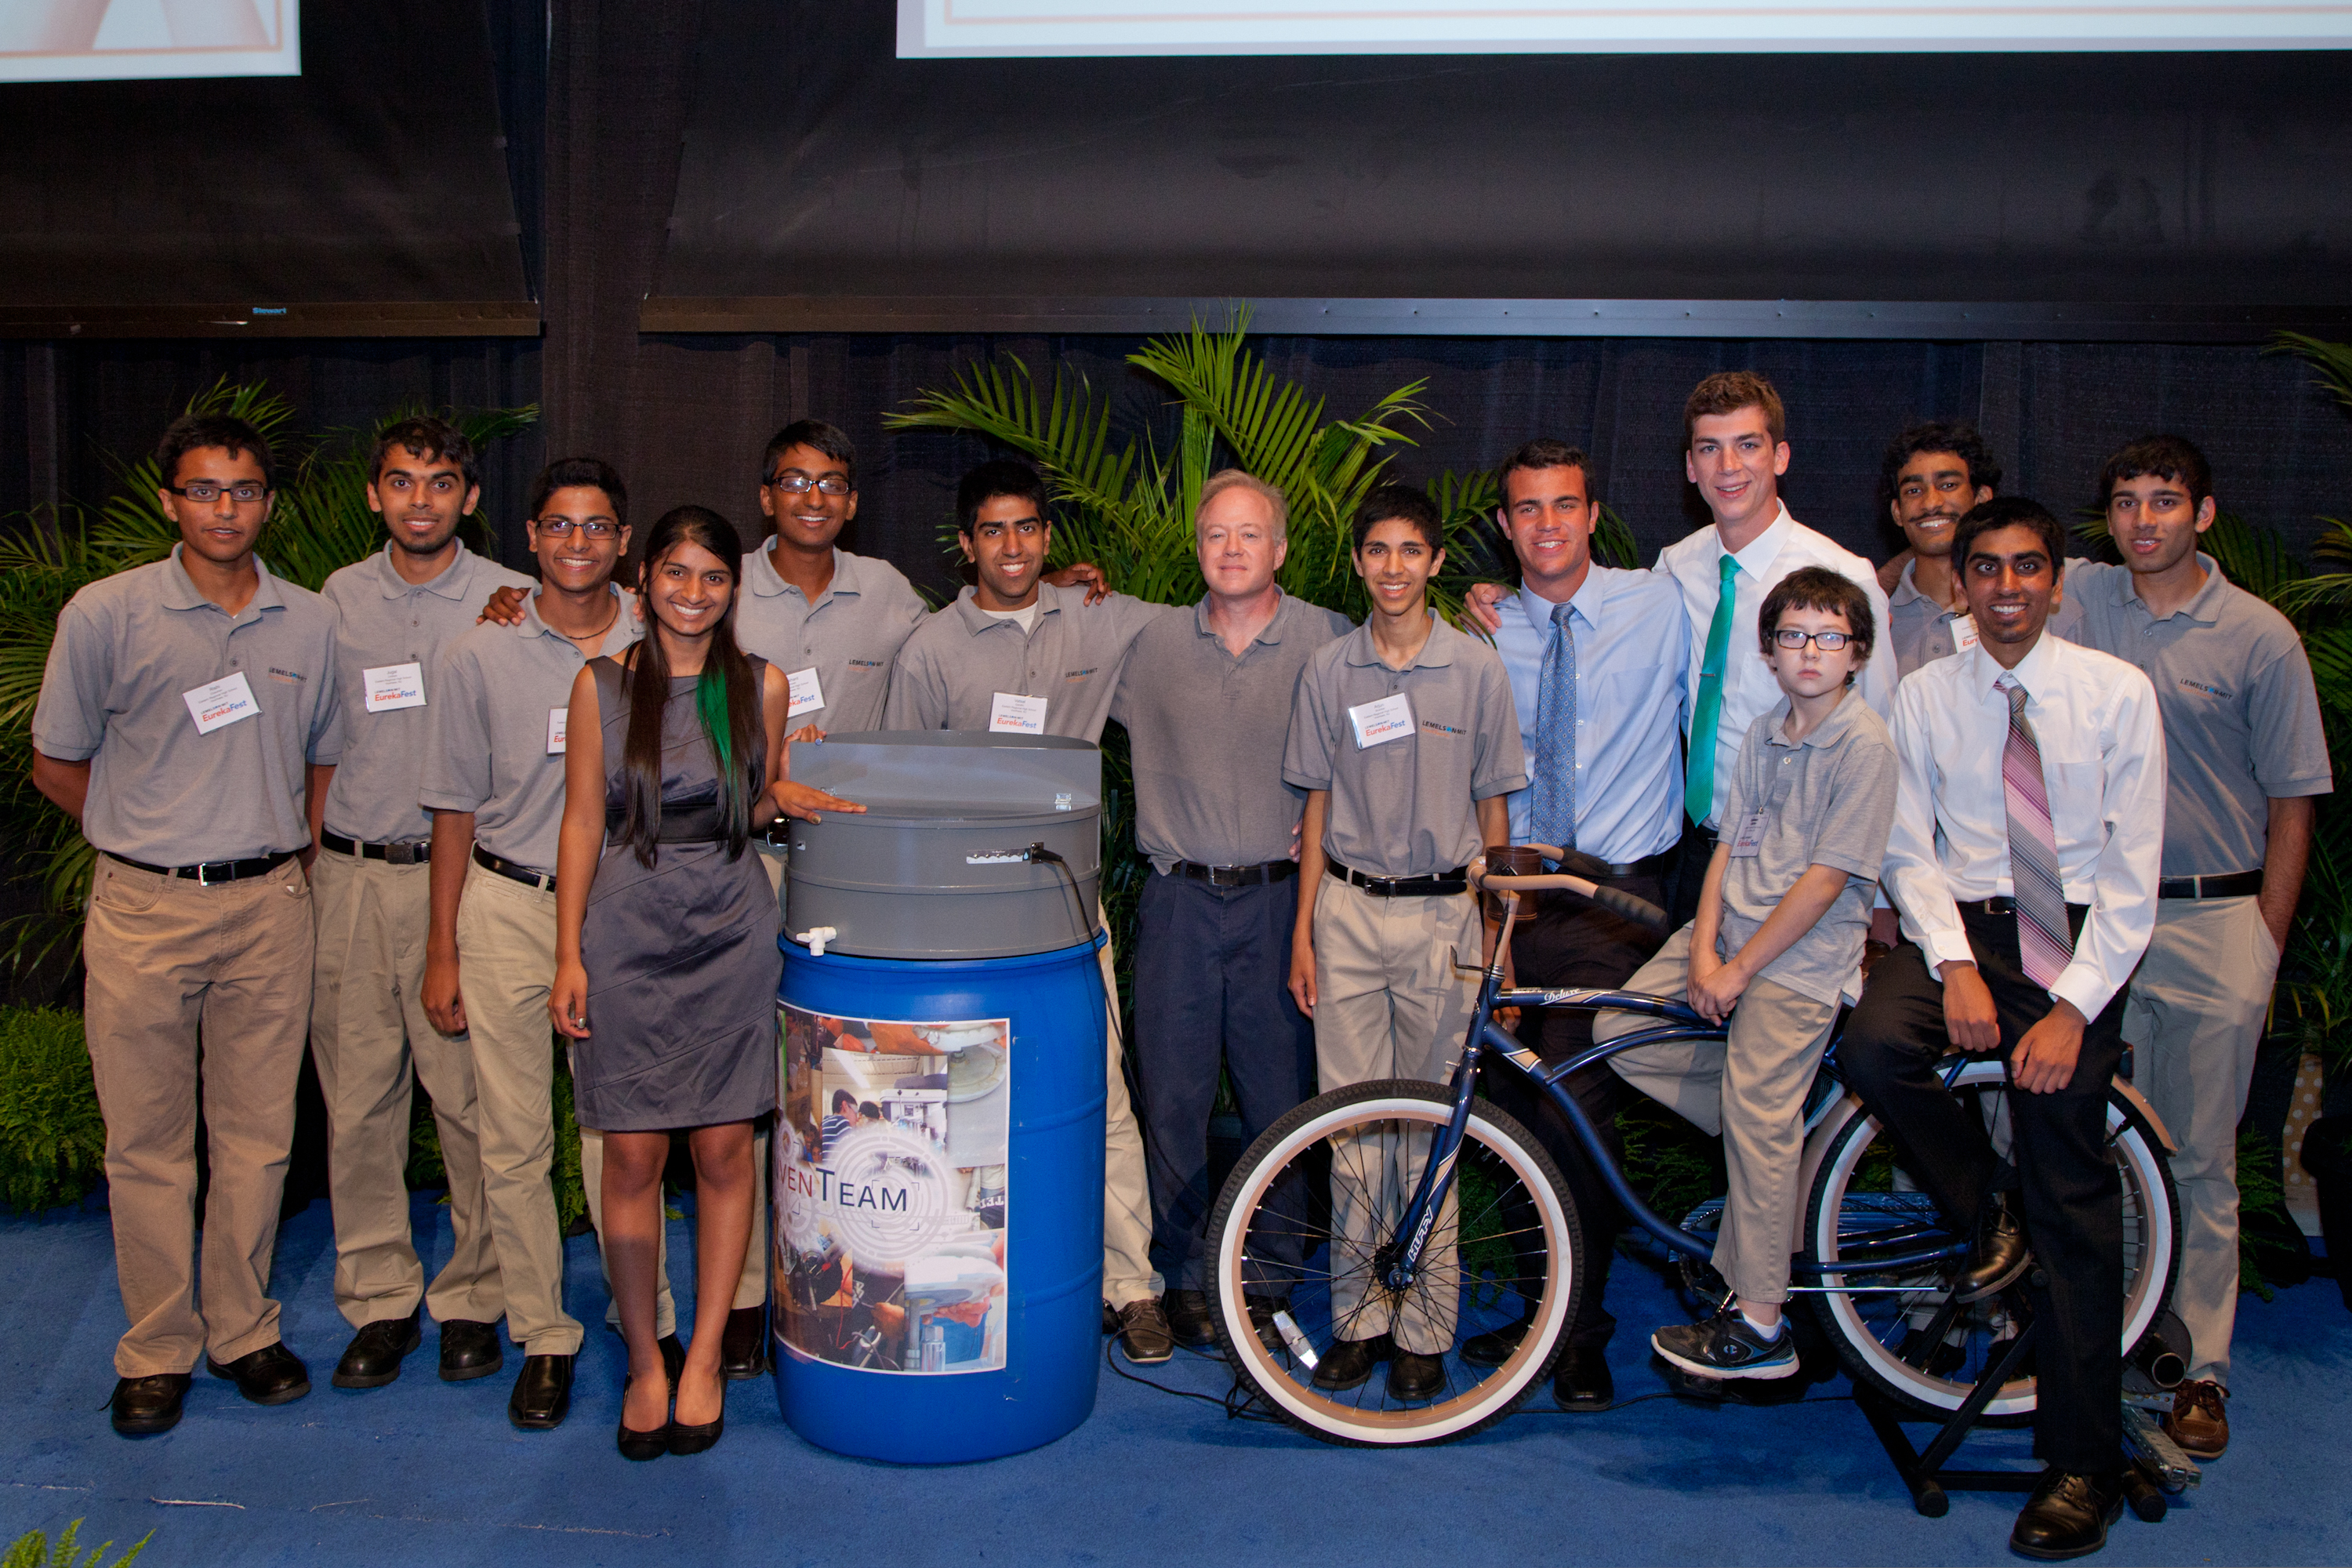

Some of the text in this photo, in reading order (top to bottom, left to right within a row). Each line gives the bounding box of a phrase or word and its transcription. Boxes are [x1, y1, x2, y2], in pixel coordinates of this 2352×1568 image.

[375, 690, 417, 702] EurekaFest
[201, 700, 248, 723] EurekaFest
[996, 717, 1037, 729] EurekaFest
[1365, 720, 1406, 737] EurekaFest
[1544, 988, 1581, 1002] Deluxe
[1407, 1204, 1434, 1263] HUFFY
